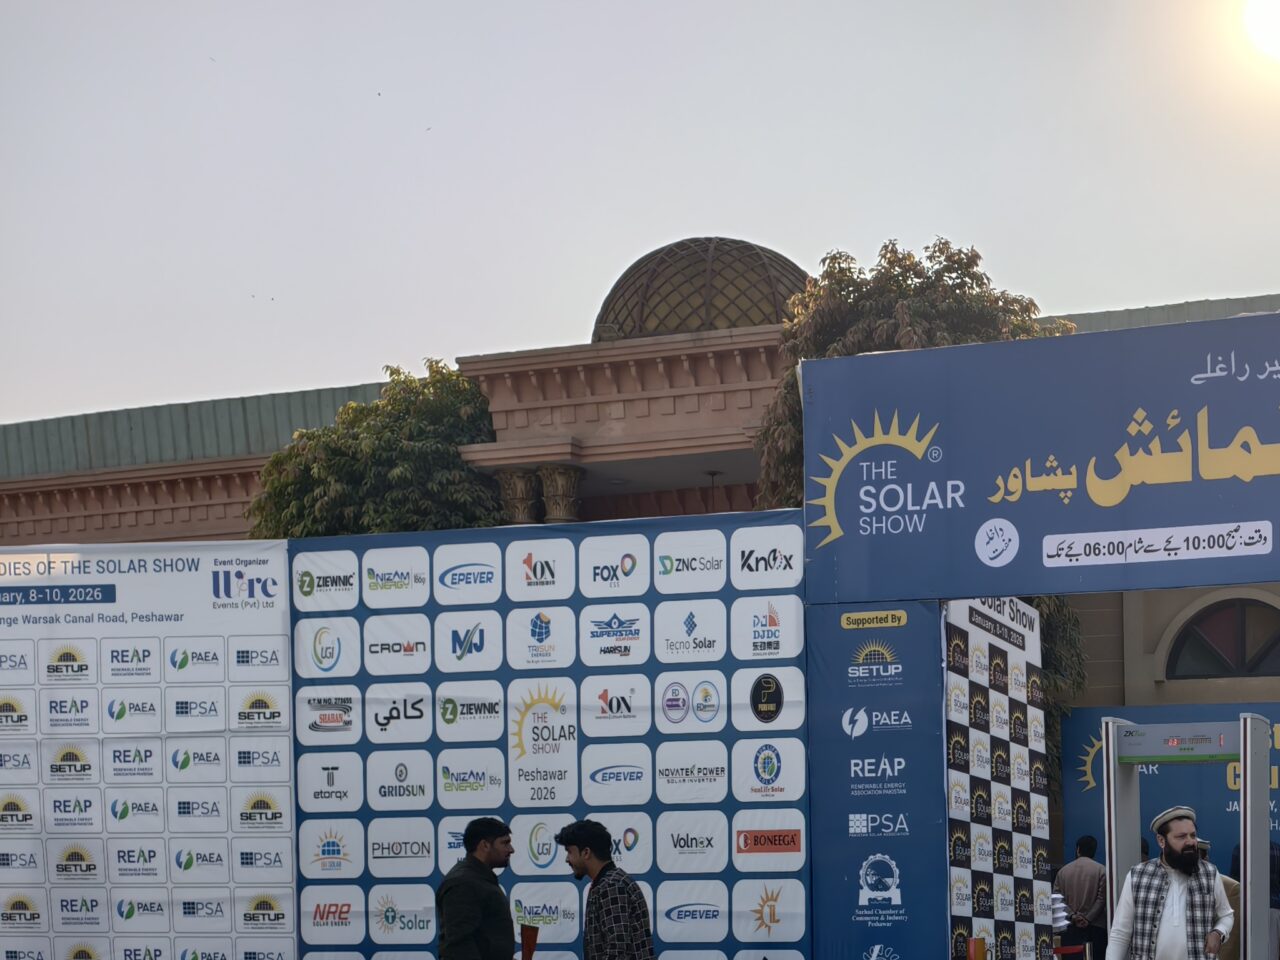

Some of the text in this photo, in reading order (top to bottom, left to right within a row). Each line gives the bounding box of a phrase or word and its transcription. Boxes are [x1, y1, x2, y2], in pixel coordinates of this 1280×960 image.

[859, 461, 897, 481] THE
[987, 454, 1077, 505] پشاور
[859, 481, 965, 513] SOLAR
[859, 514, 926, 535] SHOW
[1083, 541, 1125, 557] 06:00
[1183, 534, 1225, 550] 10:00
[36, 560, 56, 576] OF
[60, 559, 91, 575] THE
[96, 558, 148, 575] SOLAR
[152, 557, 200, 574] SHOW
[235, 558, 269, 567] Organizer
[675, 556, 723, 572] ZNC Solar
[376, 570, 410, 581] NIZAM
[451, 571, 494, 585] EPEVER
[593, 565, 619, 582] FOX
[316, 575, 354, 588] ZIEWNIC
[29, 588, 102, 603] 8-10, 2026
[212, 600, 274, 610] Events (Pvt) Ltd
[22, 611, 184, 624] Warsak Canal Road, Peshawar
[846, 614, 902, 627] Supported By
[1009, 598, 1035, 633] Show
[590, 629, 640, 638] SUPERSTAR
[752, 629, 780, 640] DJDC
[665, 638, 716, 651] Tecno Solar
[111, 649, 150, 664] REAP
[191, 651, 219, 662] PAEA
[250, 650, 279, 664] PSA
[47, 664, 88, 673] SETUP
[848, 664, 902, 678] SETUP
[532, 712, 548, 723] THE
[872, 710, 912, 725] PAEA
[532, 725, 576, 741] SOLAR
[532, 743, 560, 754] SHOW
[518, 768, 568, 781] Peshawar
[658, 764, 725, 777] NOVATEK POWER
[850, 757, 906, 778] REAP
[601, 771, 643, 782] EPEVER
[379, 784, 425, 798] GRIDSUN
[851, 782, 883, 790] RENEWABLE
[530, 787, 556, 800] 2026
[867, 814, 909, 832] PSA
[753, 834, 796, 847] BONEEGA
[372, 842, 431, 857] PHOTON
[400, 914, 431, 930] Solar
